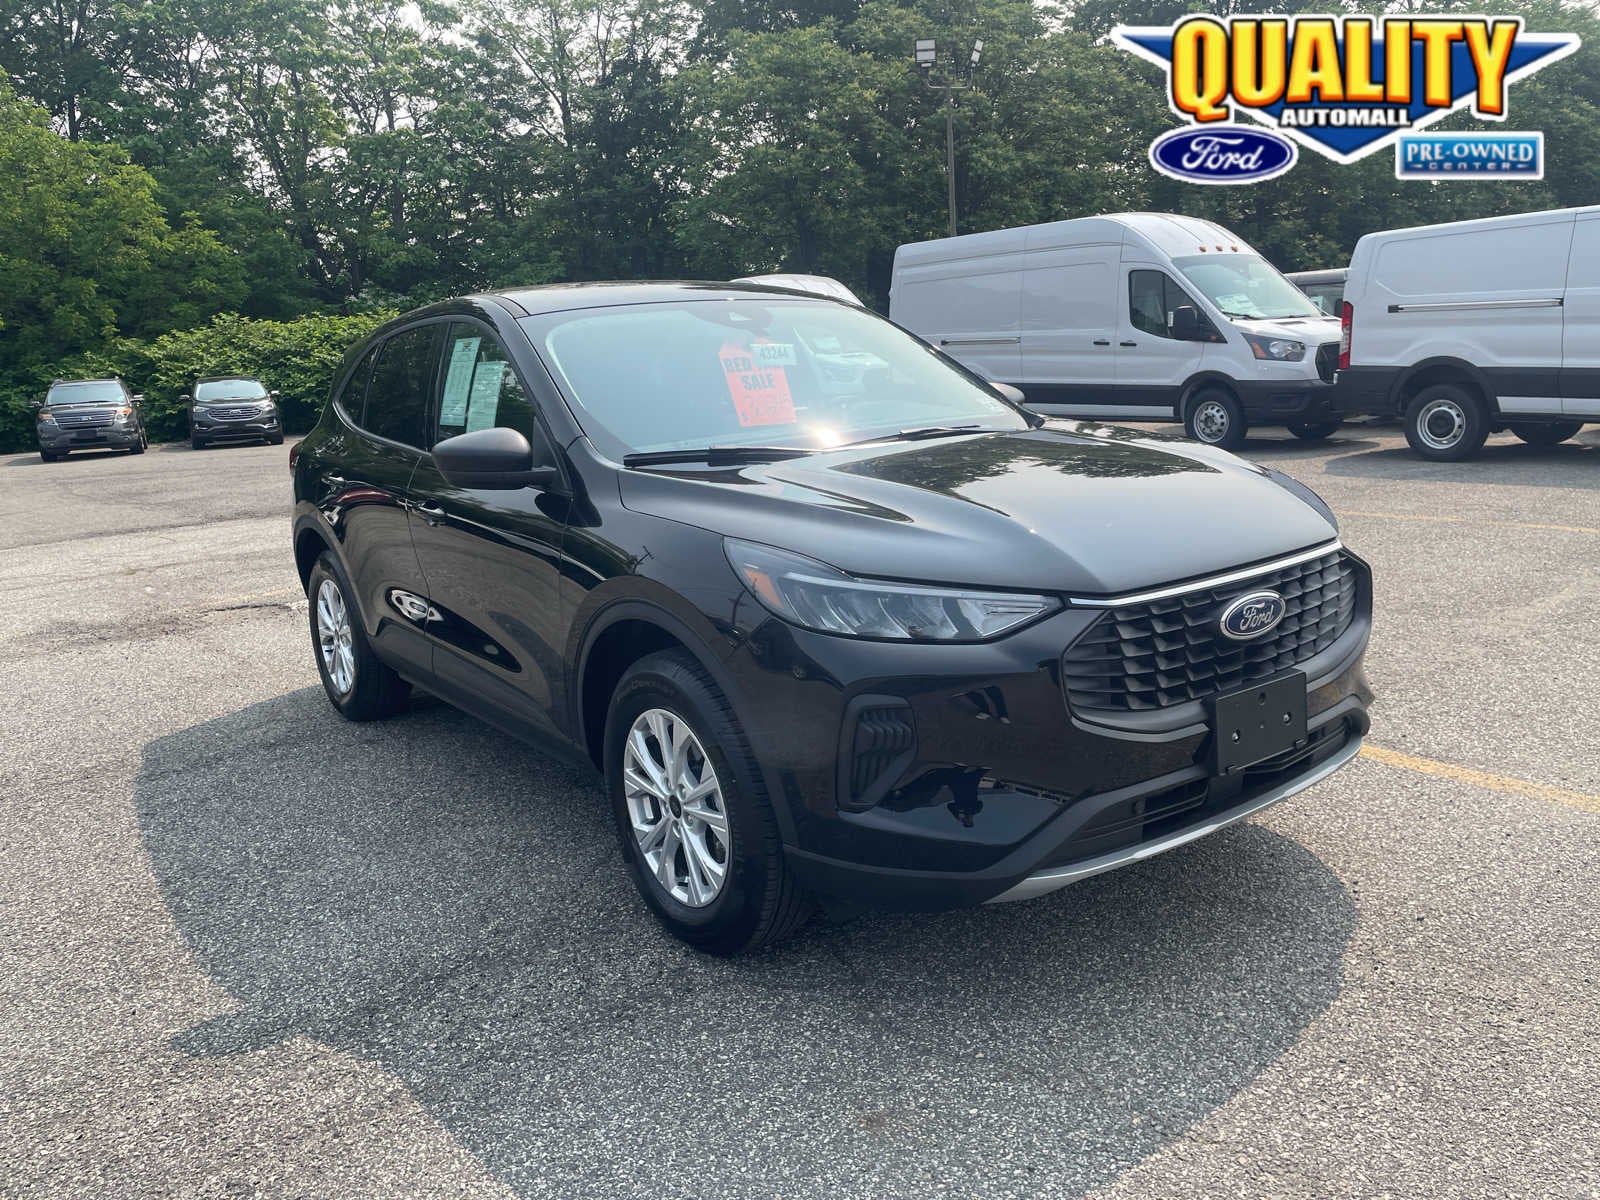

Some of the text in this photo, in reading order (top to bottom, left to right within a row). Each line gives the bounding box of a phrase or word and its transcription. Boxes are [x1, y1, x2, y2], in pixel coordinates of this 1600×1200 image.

[723, 357, 752, 373] RED
[741, 373, 776, 390] SALE
[1239, 602, 1274, 631] Ford
